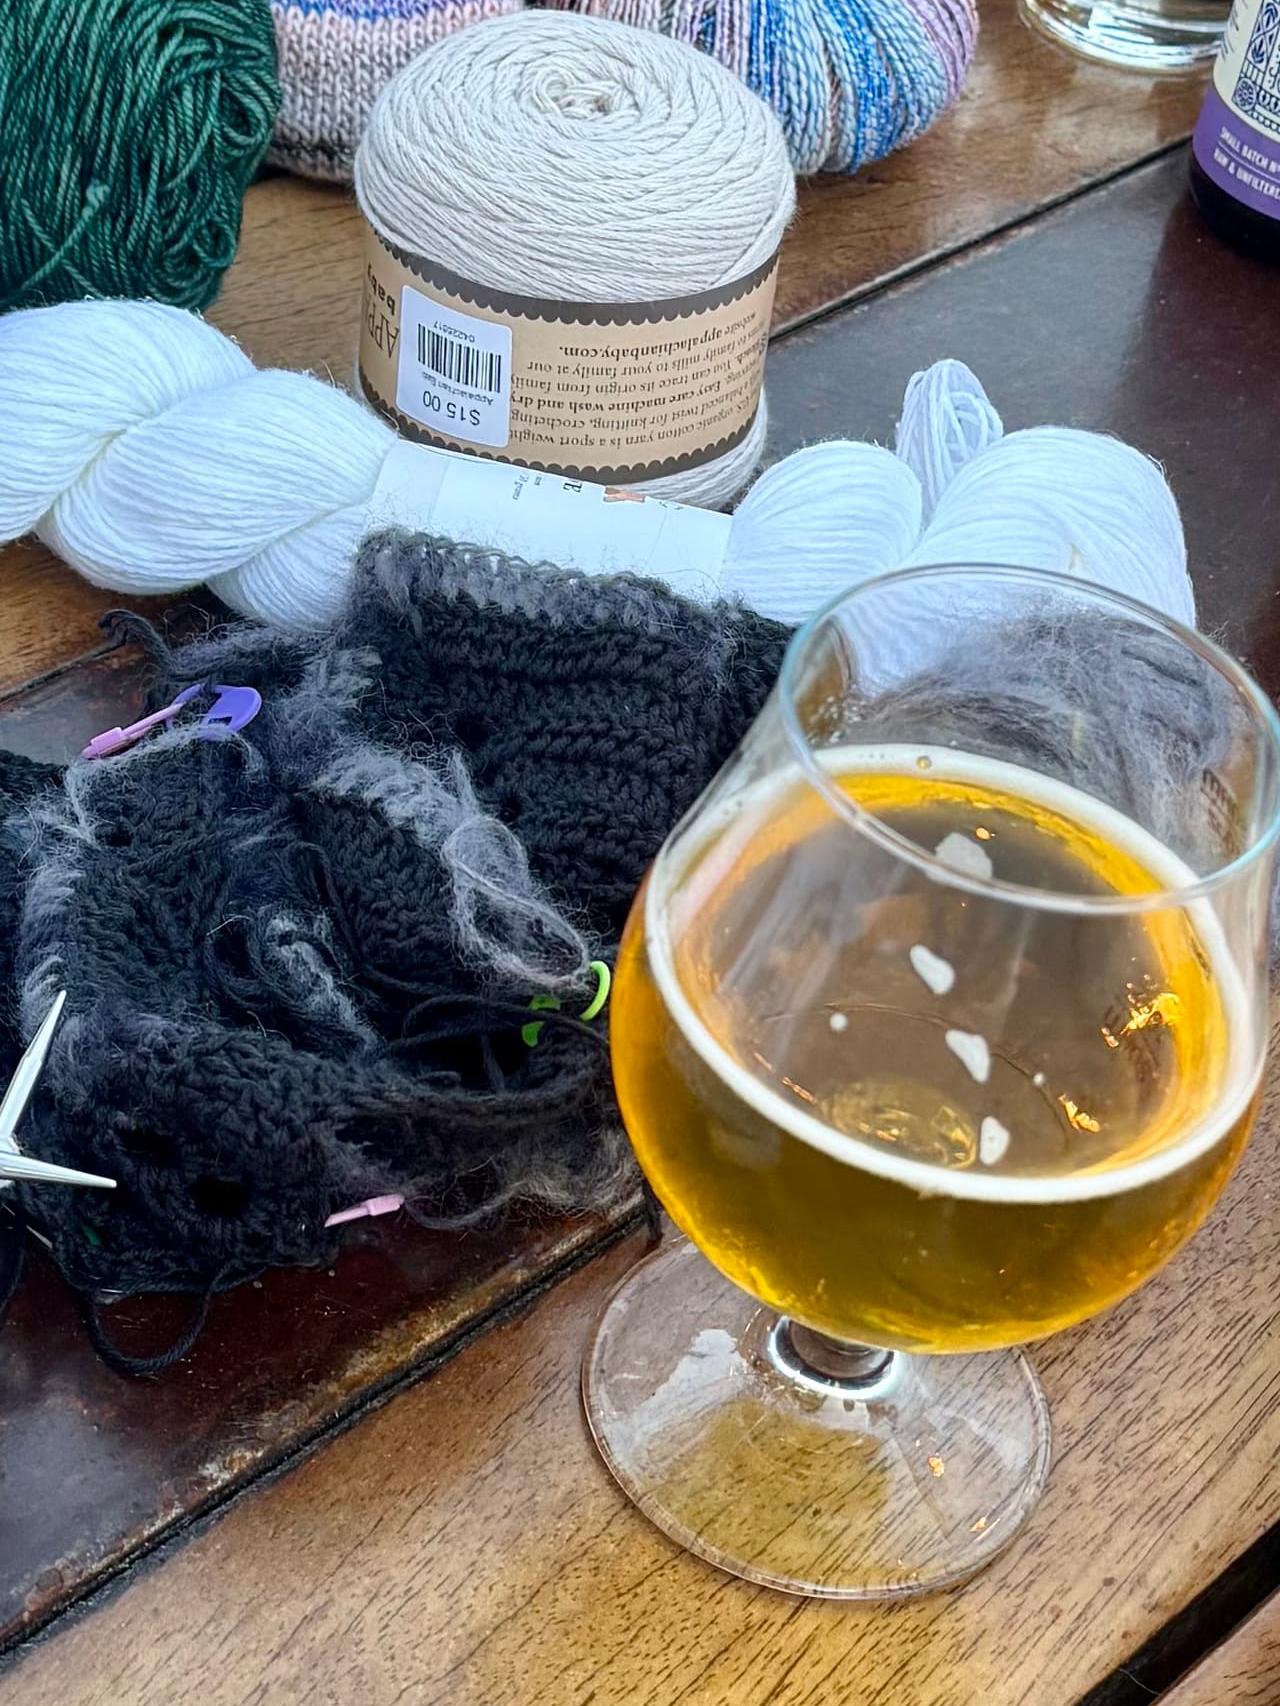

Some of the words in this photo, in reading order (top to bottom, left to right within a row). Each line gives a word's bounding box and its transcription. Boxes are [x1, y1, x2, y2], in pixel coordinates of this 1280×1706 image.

[1220, 126, 1240, 154] SMALL
[1240, 145, 1270, 171] BATCH
[1212, 147, 1228, 168] RAW
[703, 343, 736, 363] family
[527, 361, 552, 373] our
[557, 365, 569, 375] at
[620, 361, 654, 377] your
[656, 363, 668, 373] to
[672, 354, 701, 371] mills
[572, 363, 617, 380] family
[692, 369, 712, 381] can
[510, 373, 552, 394] family
[596, 381, 637, 397] origin
[640, 381, 655, 393] its
[658, 375, 688, 388] trace
[697, 380, 722, 397] Easy
[557, 383, 591, 397] from
[669, 389, 696, 404] care
[510, 391, 534, 409] dry
[538, 398, 565, 411] and
[569, 401, 605, 414] wash
[608, 396, 666, 413] machine
[650, 413, 668, 427] for
[671, 404, 699, 421] twist
[696, 407, 734, 430] organic
[509, 429, 555, 444] weight
[560, 433, 595, 447] sport
[625, 432, 654, 446] yarn
[658, 425, 695, 440] cotton
[600, 438, 607, 446] a
[610, 437, 621, 450] is
